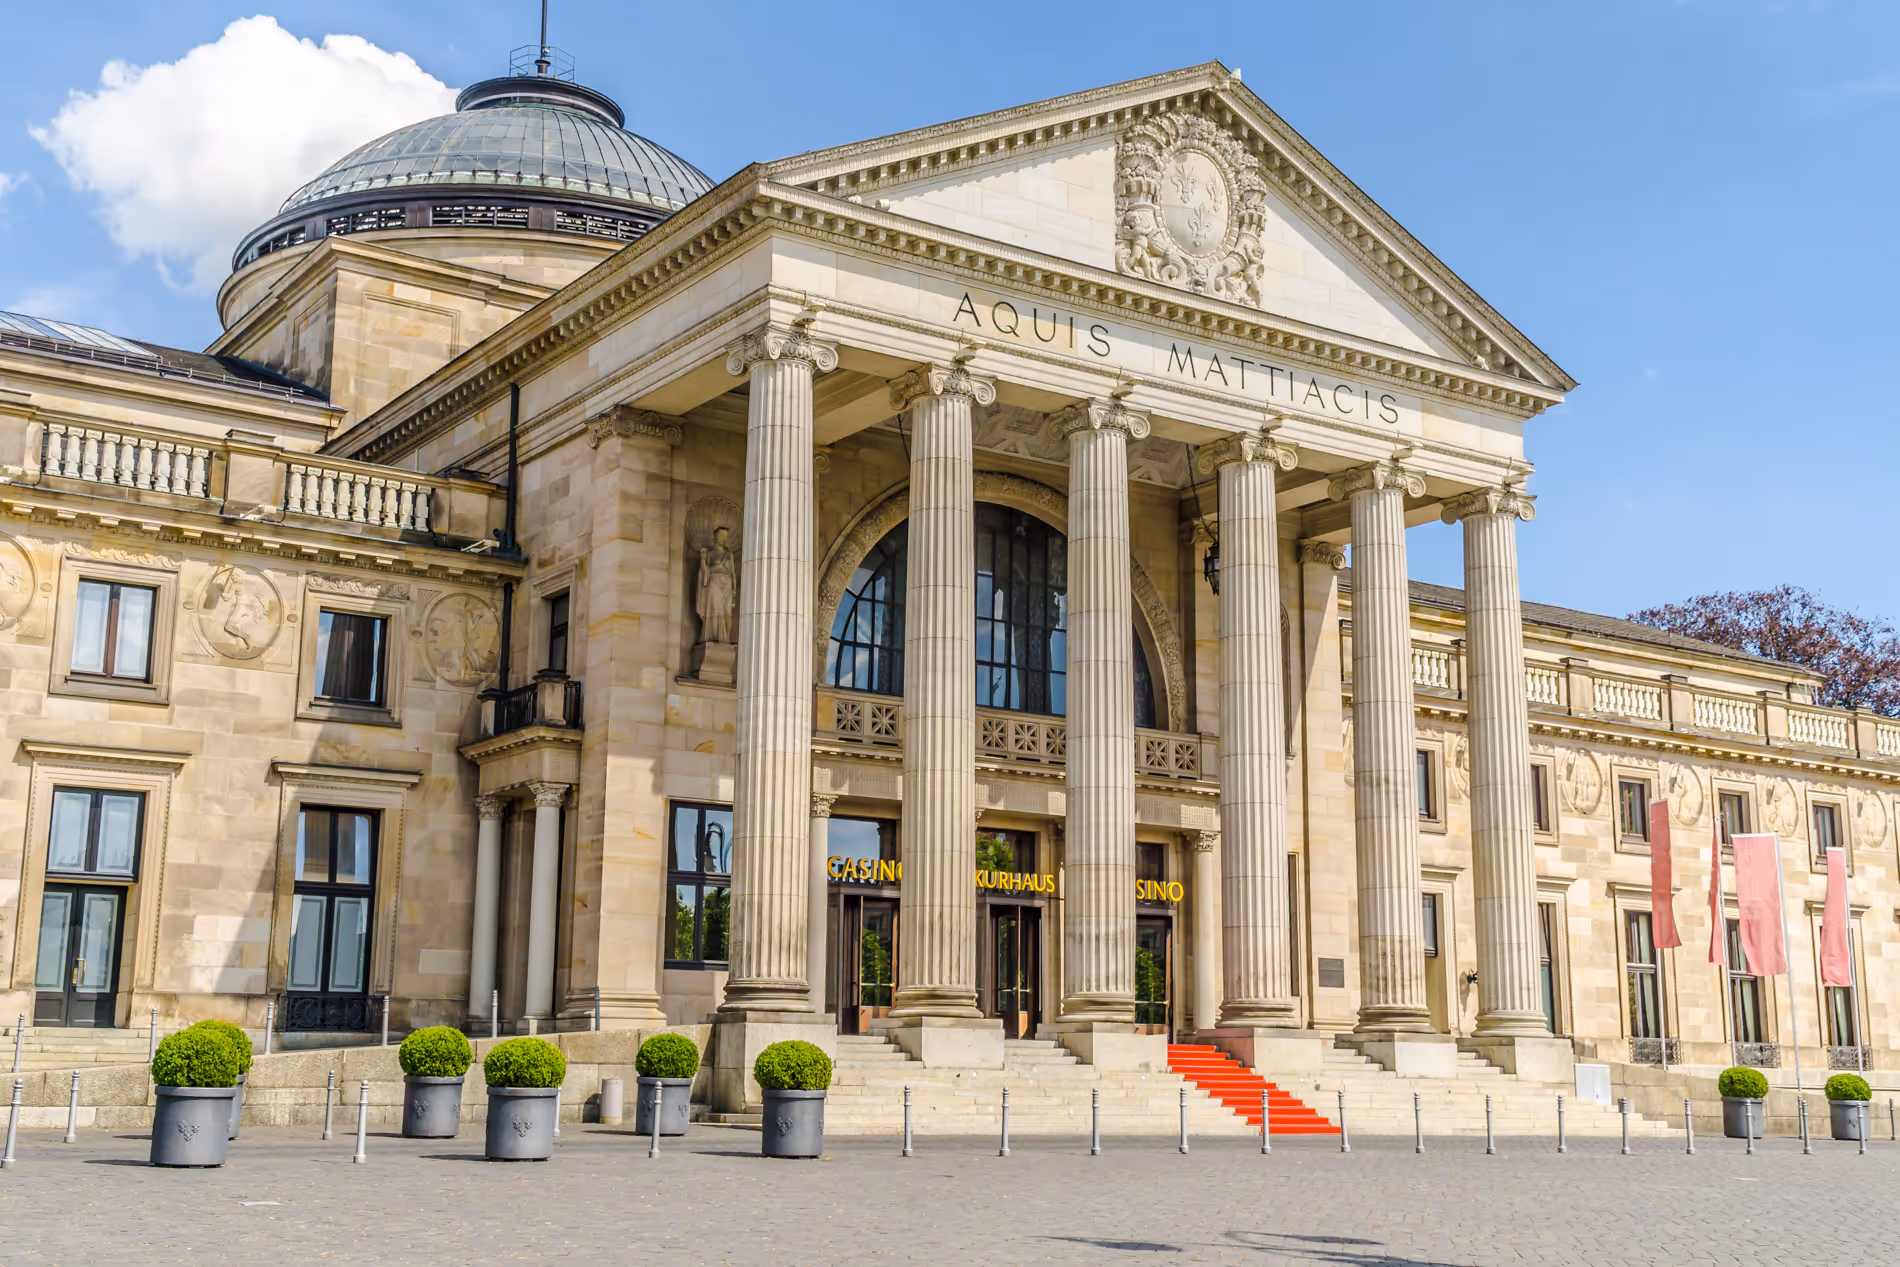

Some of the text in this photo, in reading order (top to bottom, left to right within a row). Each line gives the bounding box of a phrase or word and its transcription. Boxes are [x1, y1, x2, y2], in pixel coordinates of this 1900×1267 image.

[953, 292, 1399, 424] AQUIS MATTIACIS
[975, 869, 1056, 893] KURHAUS
[1135, 879, 1184, 902] SINO
